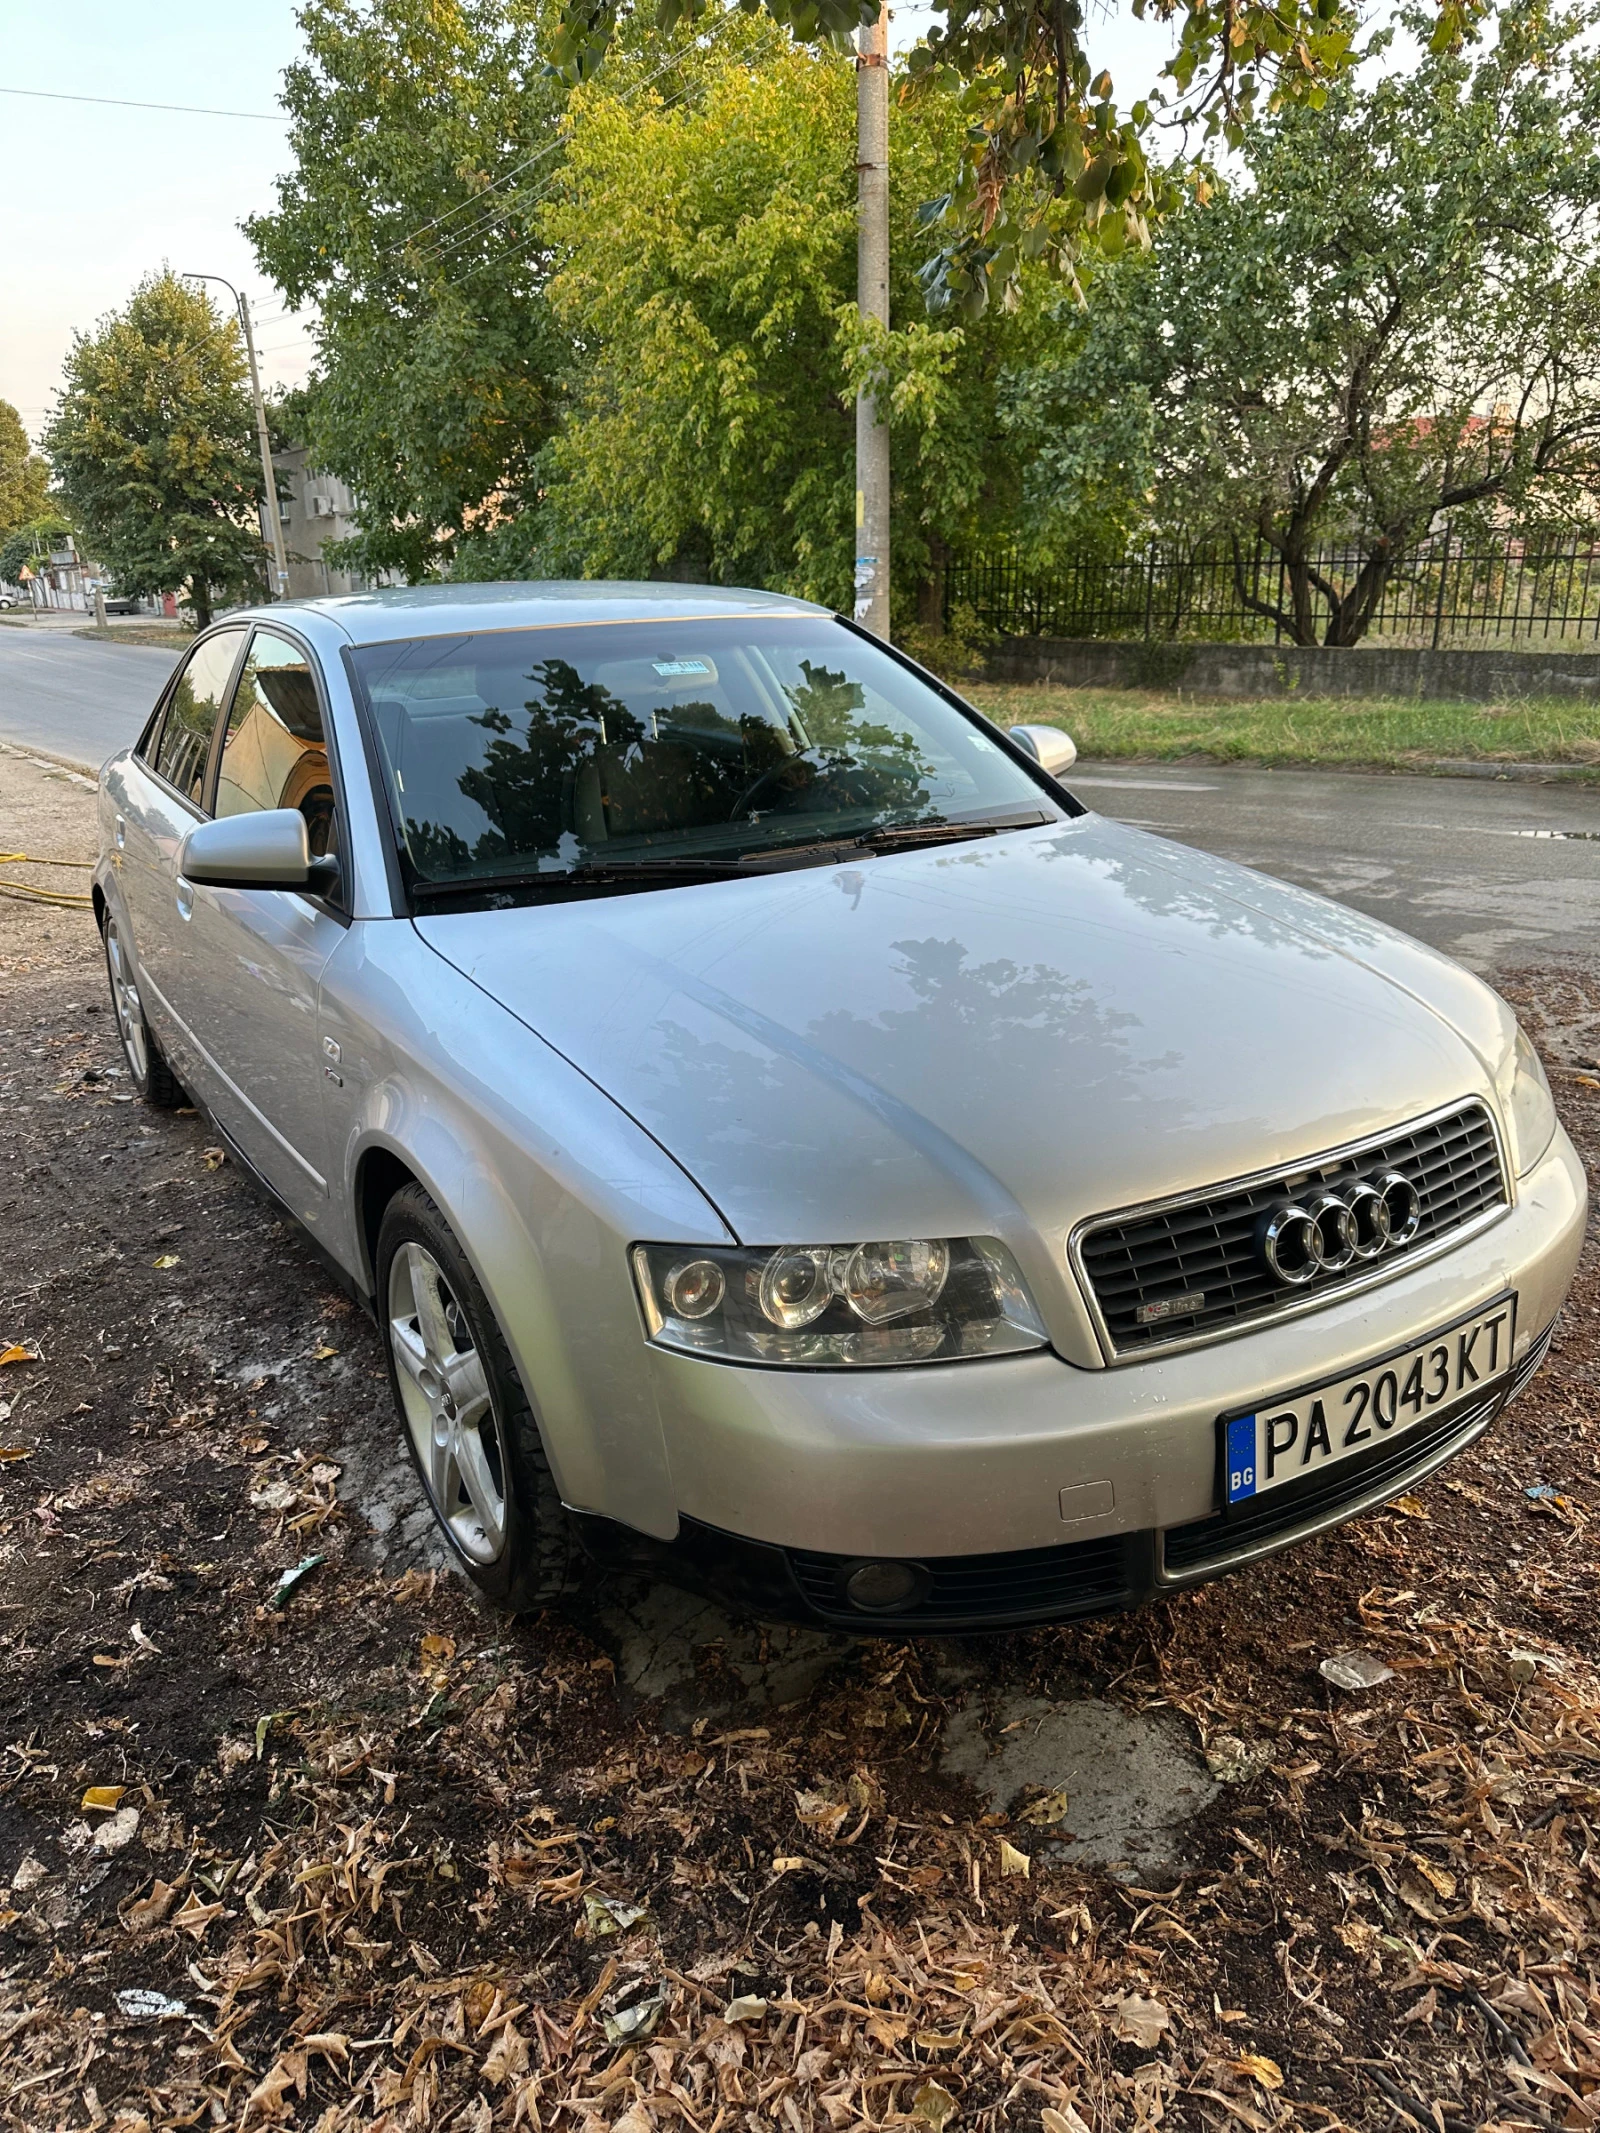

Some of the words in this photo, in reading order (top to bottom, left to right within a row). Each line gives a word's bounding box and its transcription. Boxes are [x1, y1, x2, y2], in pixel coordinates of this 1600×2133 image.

[1265, 1398, 1331, 1479] PA
[1343, 1345, 1449, 1448] 2043
[1457, 1309, 1507, 1390] KT
[1231, 1467, 1253, 1491] BG
